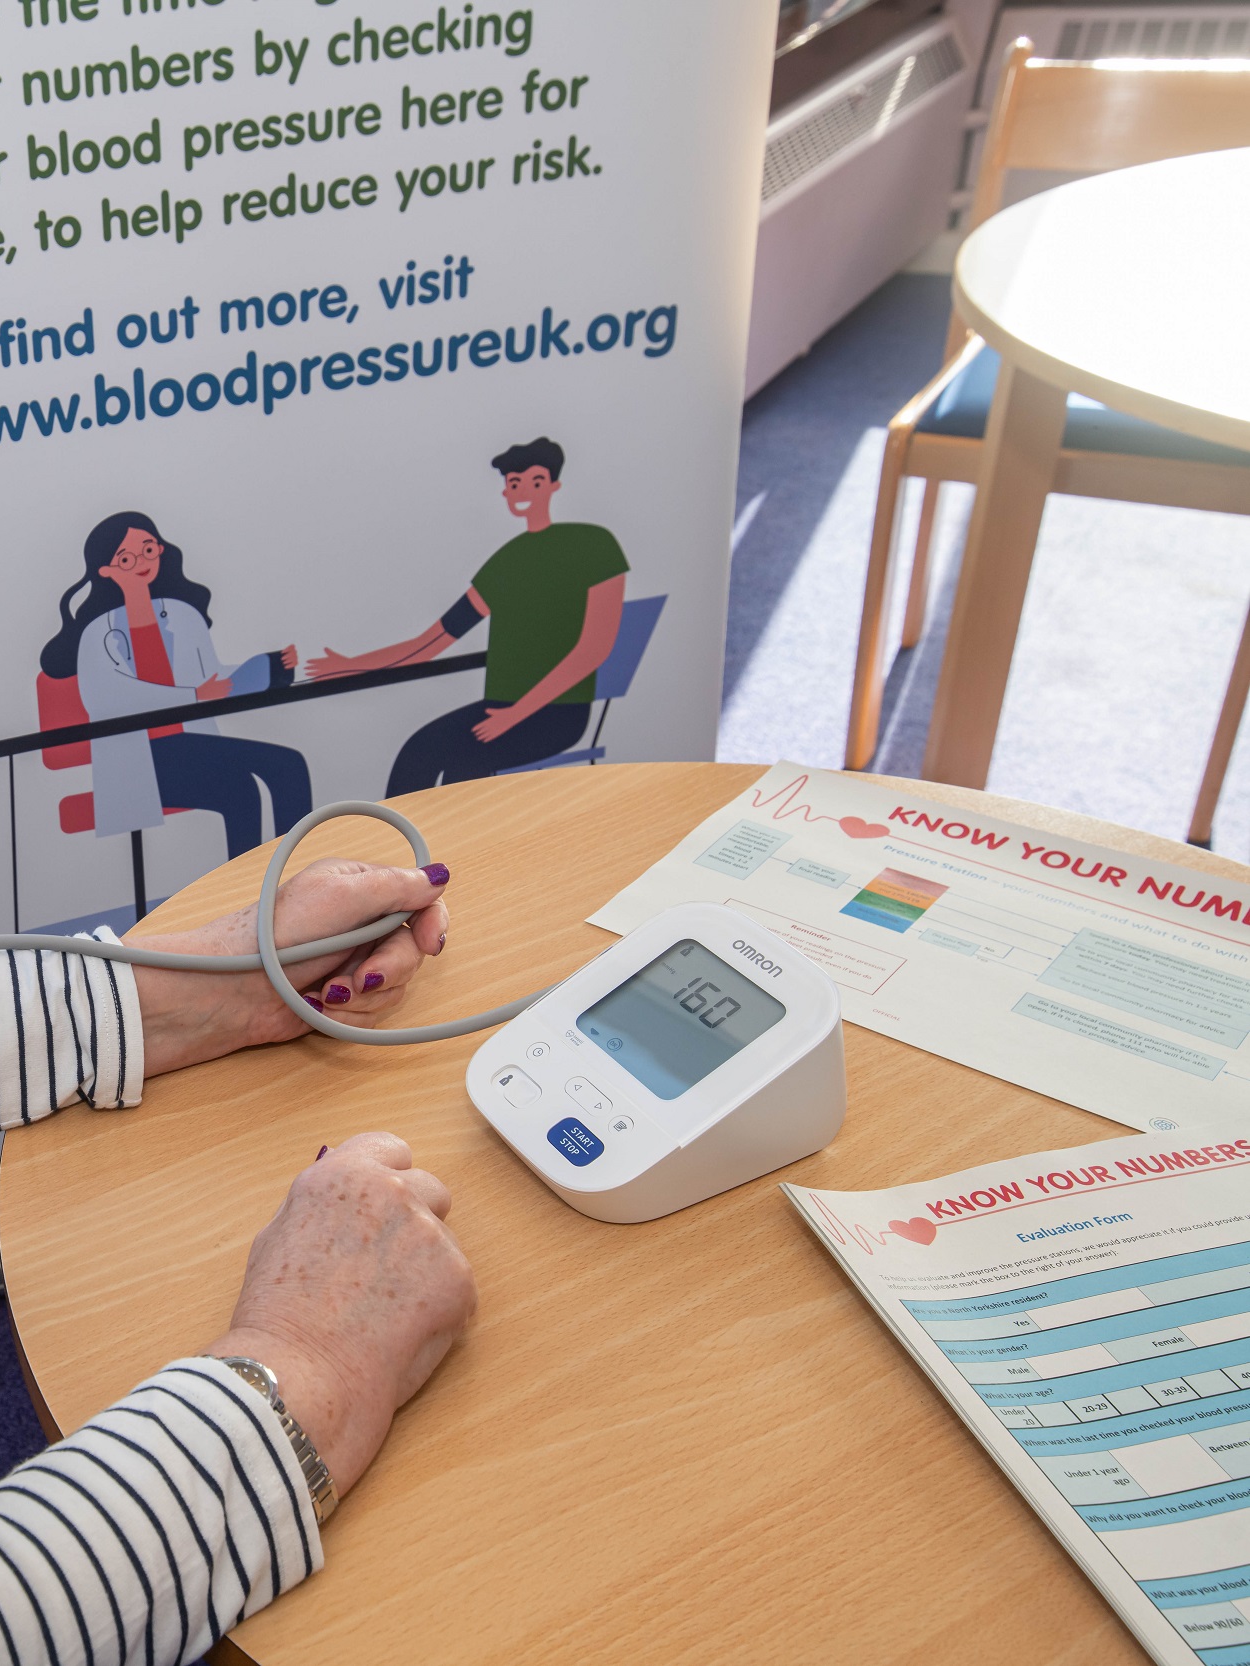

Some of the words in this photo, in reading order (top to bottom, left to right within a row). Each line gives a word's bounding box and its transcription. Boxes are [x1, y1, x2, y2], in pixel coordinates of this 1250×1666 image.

[23, 44, 234, 106] numbers
[254, 29, 309, 85] by
[327, 3, 533, 65] checking
[27, 117, 161, 180] blood
[184, 103, 381, 172] pressure
[401, 85, 504, 130] here
[521, 69, 589, 113] for
[34, 210, 82, 251] to
[102, 189, 202, 243] help
[223, 172, 378, 225] reduce
[395, 157, 495, 212] your
[513, 134, 602, 185] risk.
[117, 296, 200, 348] out
[219, 283, 359, 334] more,
[379, 254, 474, 309] visit
[888, 806, 1010, 850] KNOW
[1021, 842, 1128, 887] YOUR
[883, 844, 938, 866] Pressure
[942, 862, 987, 881] Station
[1002, 881, 1033, 897] your
[1036, 891, 1097, 916] numbers
[1100, 913, 1129, 925] and
[1132, 922, 1167, 937] what
[1172, 933, 1187, 943] to
[1191, 940, 1210, 950] do
[1216, 948, 1249, 962] with
[790, 924, 832, 941] Reminder
[732, 940, 783, 978] OMRON
[673, 977, 741, 1029] 160
[1060, 1008, 1077, 1017] your
[1079, 1014, 1097, 1024] local
[1098, 1021, 1143, 1039] community
[1143, 1037, 1184, 1054] pharmacy
[560, 1137, 580, 1155] STOP
[571, 1126, 595, 1148] START
[926, 1181, 1025, 1219] KNOW
[1025, 1165, 1117, 1194] YOUR
[1114, 1139, 1250, 1178] NUMBERS
[1016, 1219, 1094, 1243] Evaluation
[1093, 1212, 1134, 1226] Form
[950, 1271, 965, 1279] and
[966, 1266, 998, 1277] improve
[999, 1262, 1013, 1271] the
[1014, 1255, 1049, 1268] pressure
[1096, 1238, 1121, 1249] would
[1121, 1230, 1162, 1244] appreciate
[1176, 1226, 1192, 1234] you
[1192, 1221, 1214, 1230] could
[1214, 1215, 1245, 1227] provide
[888, 1283, 930, 1291] information
[959, 1279, 979, 1288] mark
[980, 1276, 995, 1284] the
[995, 1273, 1010, 1281] box
[1020, 1267, 1035, 1276] the
[1035, 1262, 1056, 1273] right
[1064, 1257, 1084, 1266] your
[948, 1306, 972, 1314] North
[971, 1301, 1010, 1312] Yorkshire
[1011, 1291, 1049, 1305] resident?
[945, 1348, 968, 1356] What
[976, 1348, 995, 1356] your
[996, 1343, 1029, 1355] gender?
[1152, 1336, 1185, 1348] Female
[1007, 1367, 1031, 1375] Male
[982, 1392, 1005, 1400] What
[1014, 1391, 1033, 1400] your
[1035, 1388, 1054, 1398] age?
[1160, 1385, 1188, 1397] 30-39
[1000, 1408, 1026, 1416] Under
[1082, 1402, 1109, 1413] 20-29
[1023, 1418, 1036, 1426] 20
[1023, 1439, 1048, 1447] When
[1049, 1438, 1067, 1446] was
[1067, 1436, 1081, 1444] the
[1081, 1433, 1100, 1442] last
[1100, 1430, 1120, 1440] time
[1121, 1427, 1139, 1436] you
[1138, 1418, 1176, 1432] checked
[1175, 1415, 1196, 1425] your
[1195, 1407, 1224, 1419] blood
[1208, 1441, 1250, 1453] Between
[1063, 1469, 1092, 1479] Under
[1092, 1468, 1100, 1476] 1
[1099, 1466, 1120, 1476] year
[1113, 1478, 1130, 1487] ago
[1085, 1515, 1108, 1524] Why
[1108, 1513, 1123, 1522] did
[1123, 1512, 1141, 1522] you
[1141, 1508, 1166, 1518] want
[1178, 1501, 1205, 1512] check
[1205, 1496, 1227, 1507] your
[1149, 1590, 1177, 1600] What
[1177, 1588, 1197, 1597] was
[1196, 1585, 1219, 1596] your
[1218, 1578, 1249, 1591] blood
[1183, 1622, 1214, 1633] Below
[1213, 1617, 1244, 1630] 90/60
